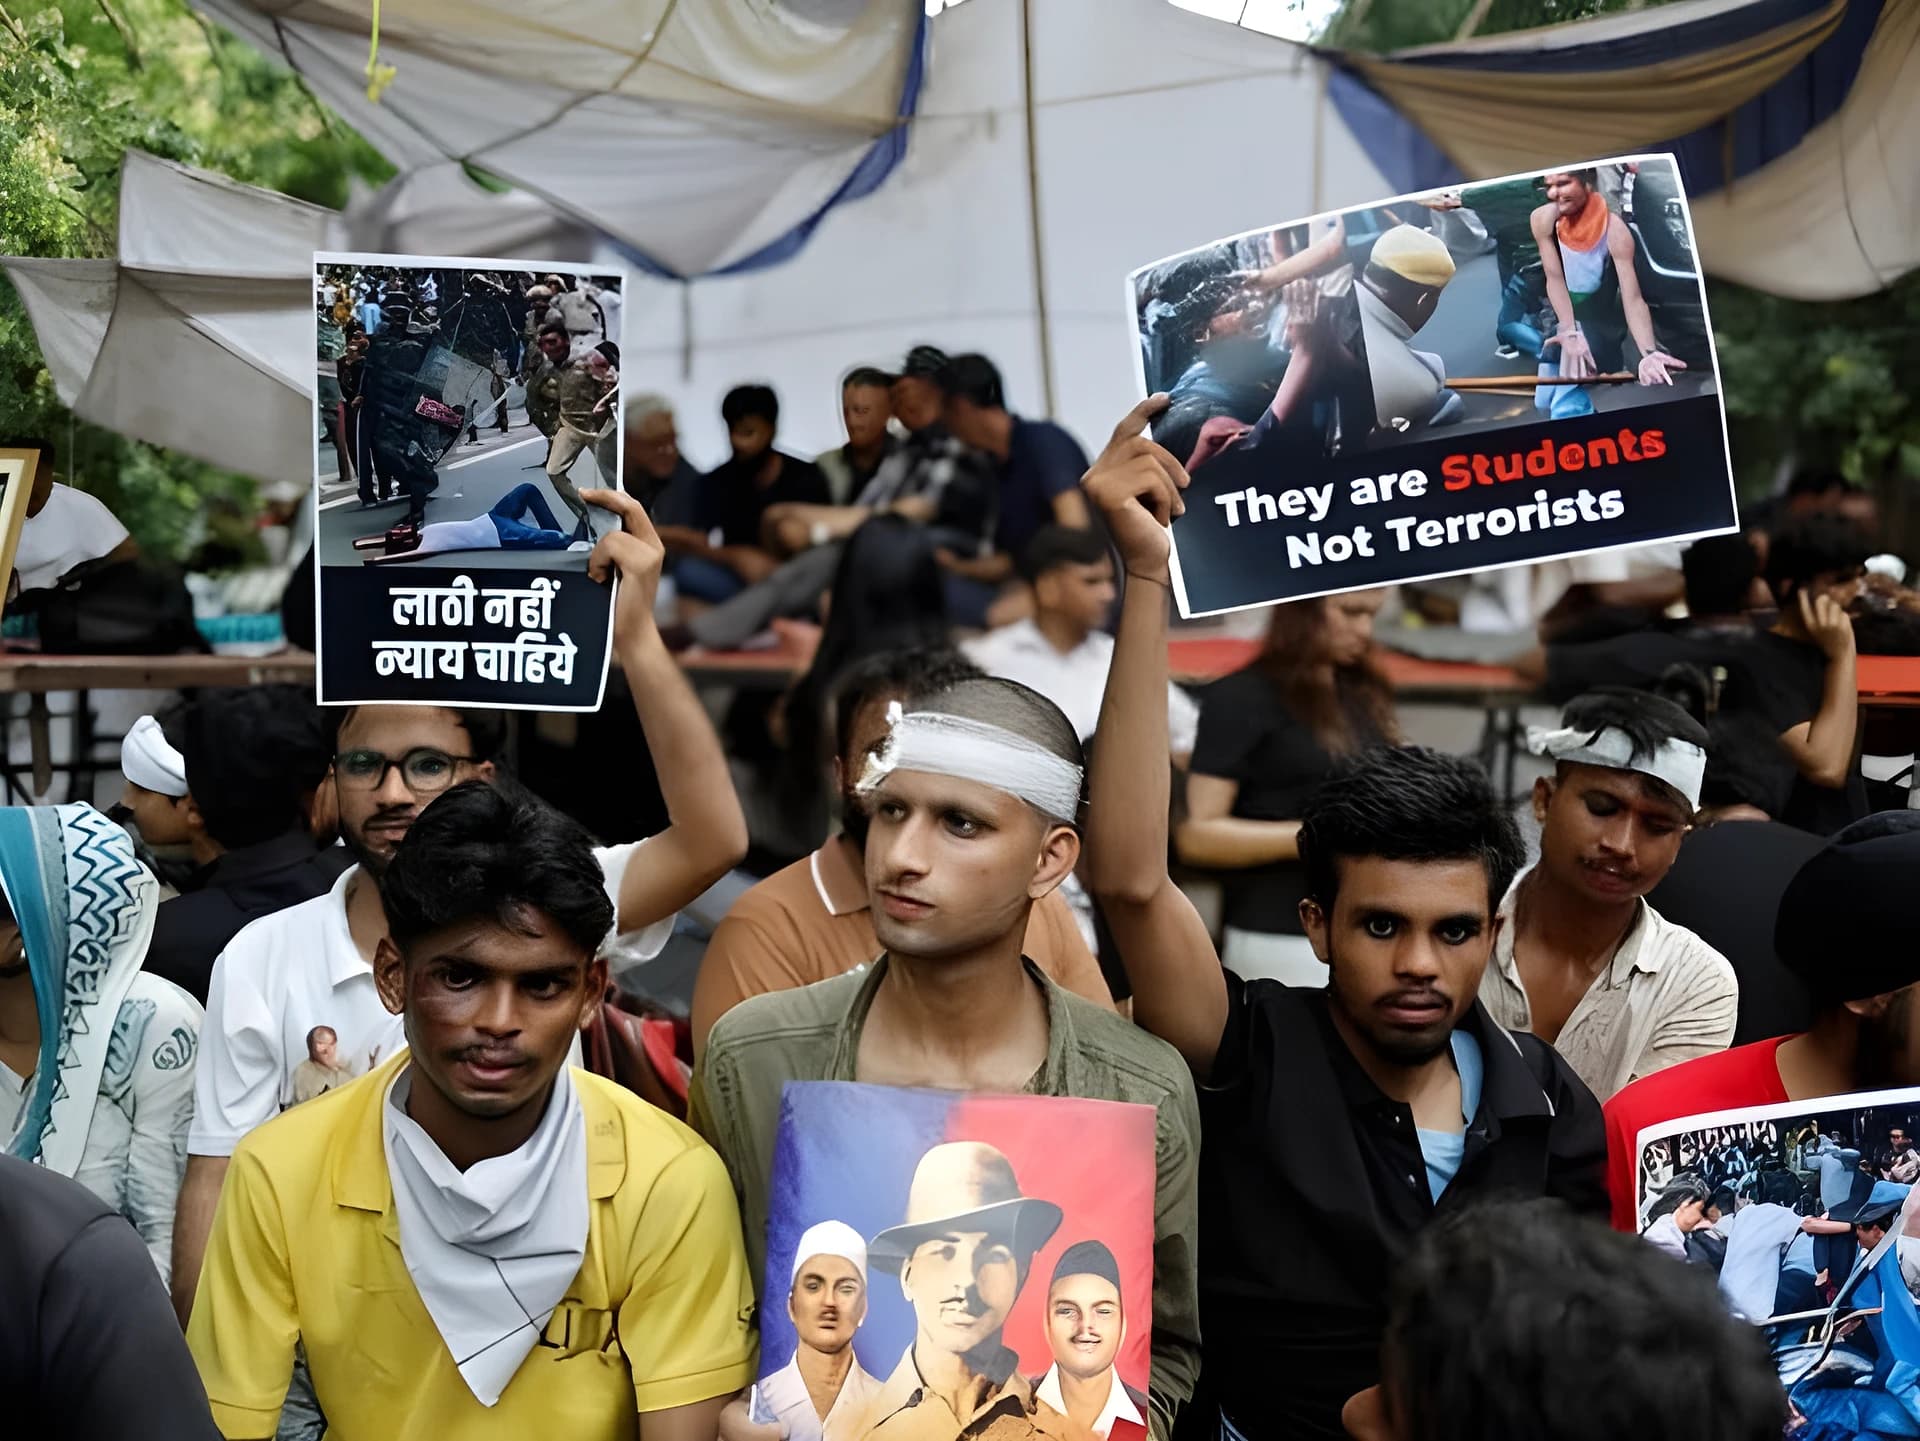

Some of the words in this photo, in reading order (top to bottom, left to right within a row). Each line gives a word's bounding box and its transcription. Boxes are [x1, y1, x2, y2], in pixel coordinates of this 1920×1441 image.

[1215, 486, 1334, 526] They
[1350, 469, 1428, 505] are
[1286, 526, 1376, 568] Not
[1385, 488, 1625, 551] Terrorists
[389, 575, 478, 626] लाठी
[481, 577, 561, 629] नहीं
[372, 641, 468, 679] न्याय
[471, 632, 578, 685] चाहिये
